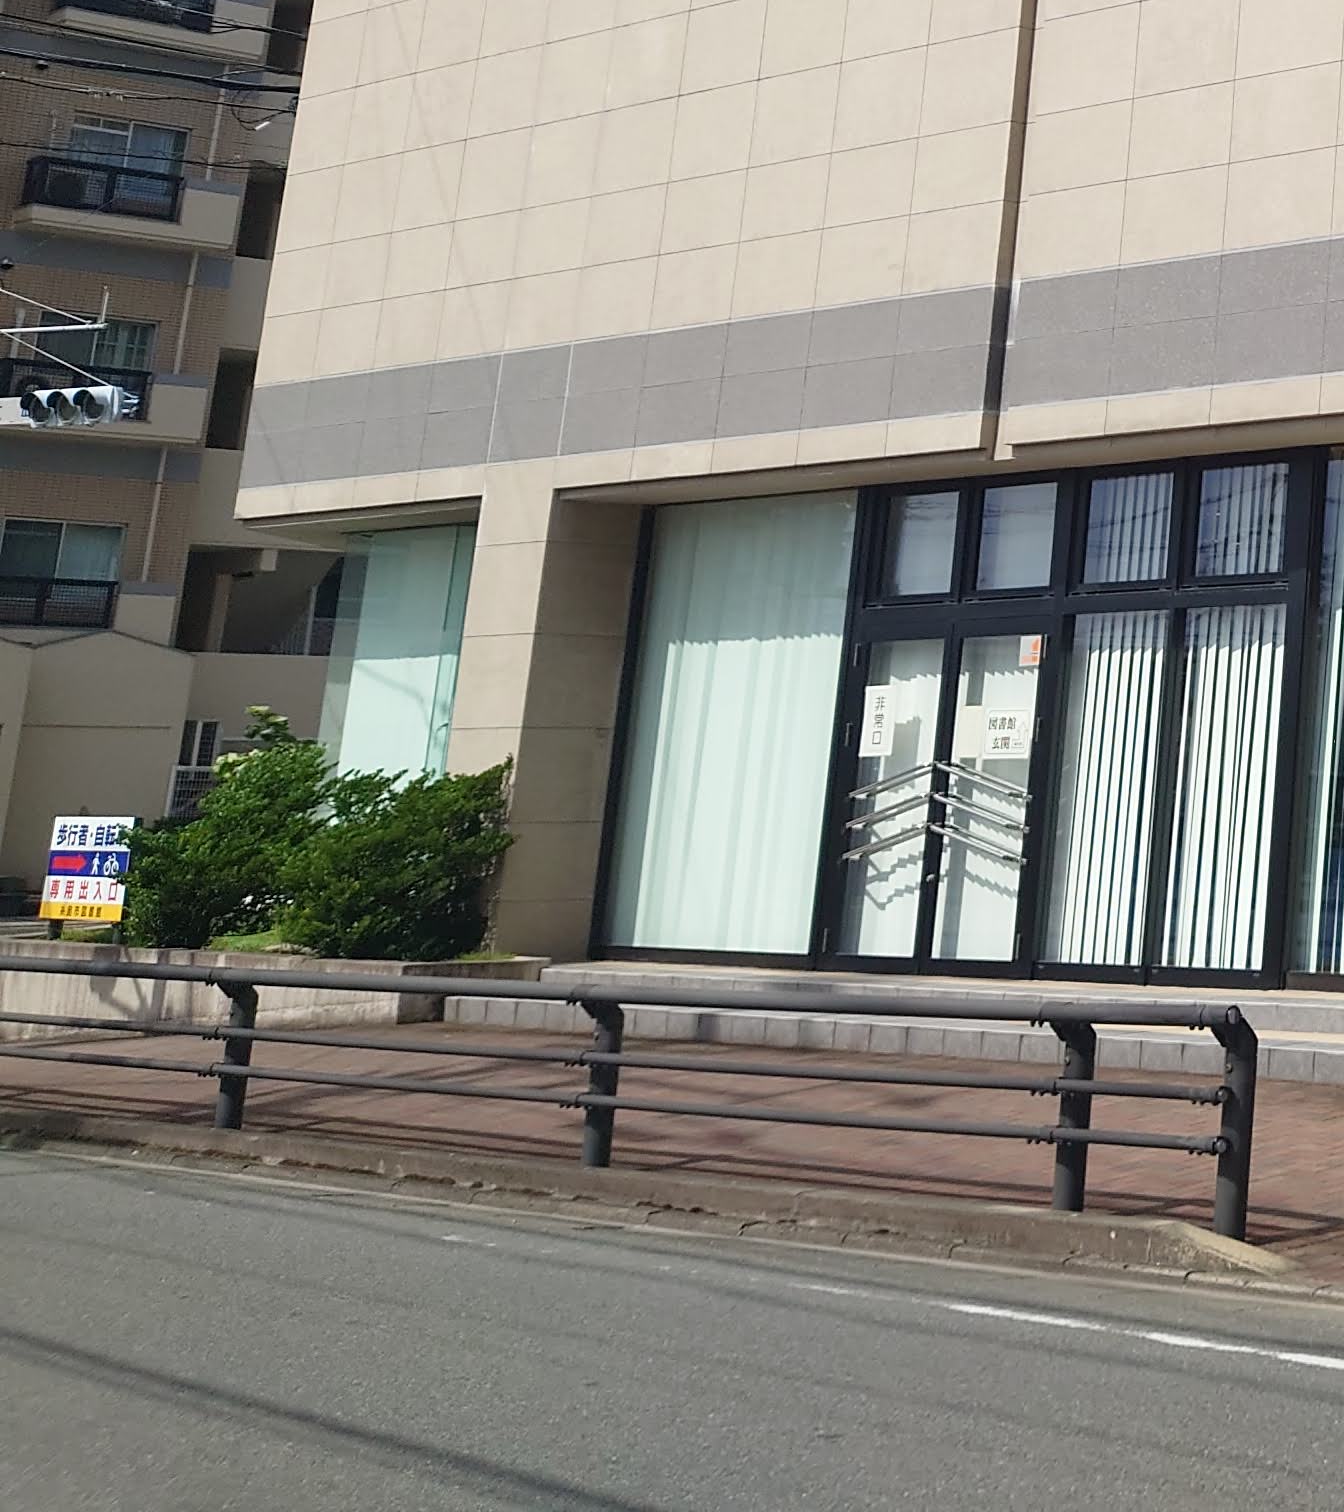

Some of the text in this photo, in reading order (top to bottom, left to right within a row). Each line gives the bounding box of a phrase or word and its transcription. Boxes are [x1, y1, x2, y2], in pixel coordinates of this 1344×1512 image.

[871, 695, 886, 746] 非常口
[988, 716, 1017, 731] 図書館
[991, 736, 1011, 750] 玄関
[49, 878, 119, 901] 専用出入口
